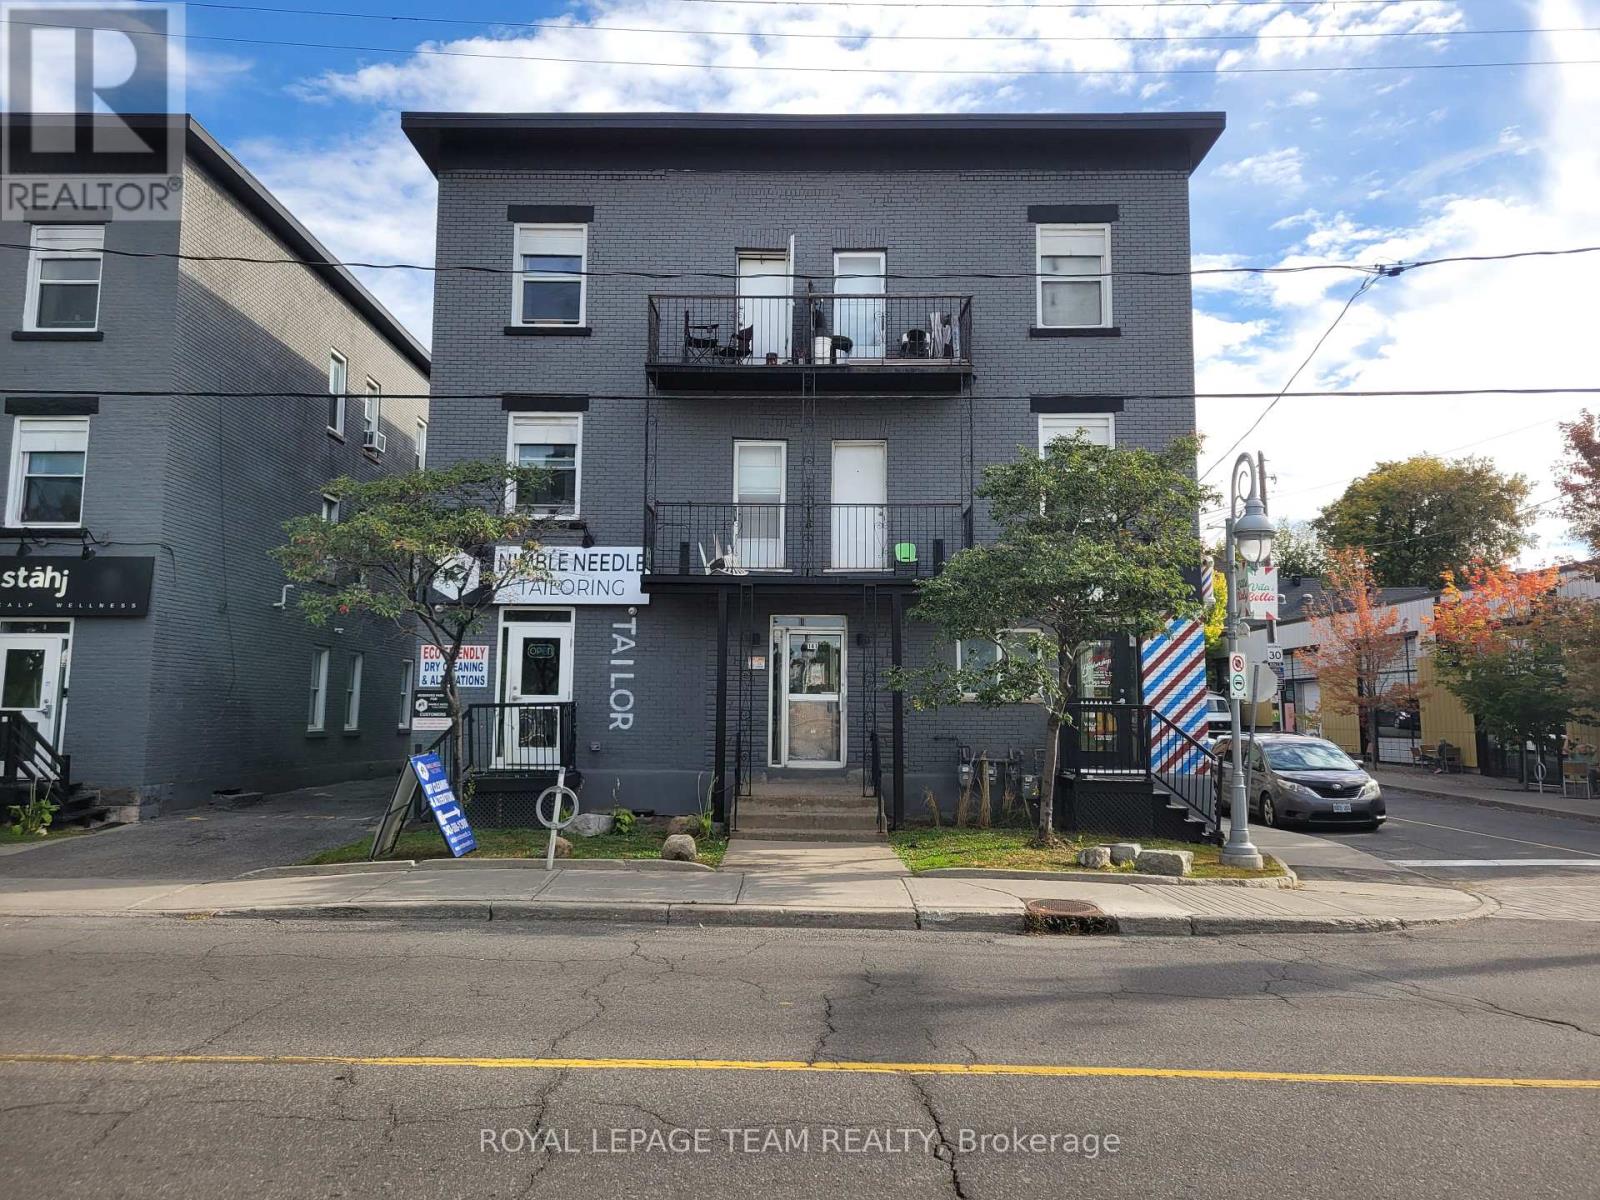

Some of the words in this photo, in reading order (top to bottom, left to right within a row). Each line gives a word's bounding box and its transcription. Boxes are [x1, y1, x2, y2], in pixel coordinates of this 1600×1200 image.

[574, 553, 645, 571] NEEDLE
[519, 578, 625, 596] TAILORING
[1248, 582, 1270, 592] Vita
[1247, 592, 1276, 602] Bella
[1269, 651, 1282, 660] 30
[424, 661, 441, 672] DRY
[443, 661, 484, 672] CEANING
[609, 617, 636, 730] TAILOR
[421, 675, 428, 685] &
[430, 675, 486, 686] ALTATIONS
